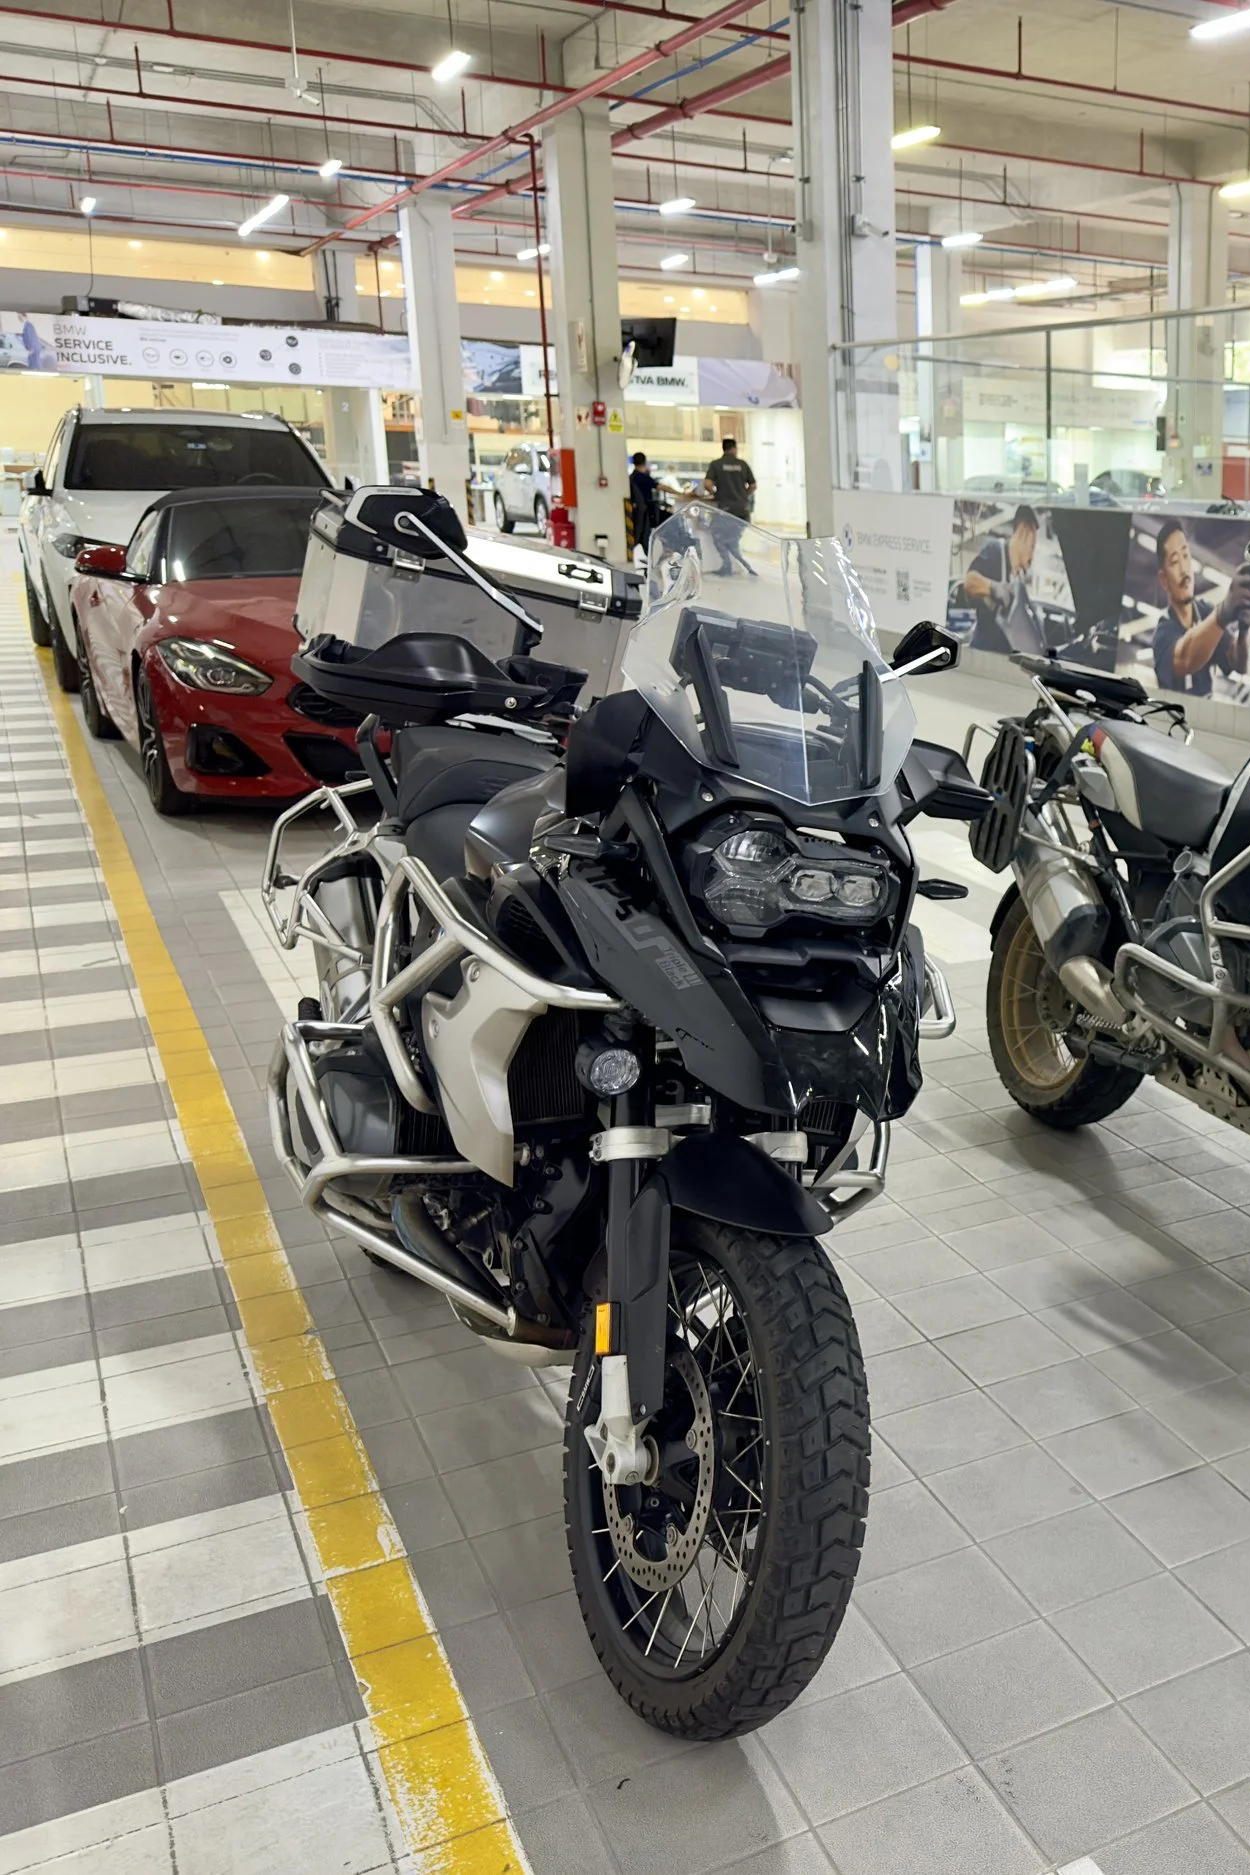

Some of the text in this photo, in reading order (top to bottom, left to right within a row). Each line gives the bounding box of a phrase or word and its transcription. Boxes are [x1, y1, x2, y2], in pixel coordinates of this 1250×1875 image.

[53, 323, 87, 337] BMW
[54, 337, 114, 351] SERVICE
[56, 352, 133, 366] INCLUSIVE.
[662, 945, 689, 974] Triple
[658, 959, 686, 988] Black
